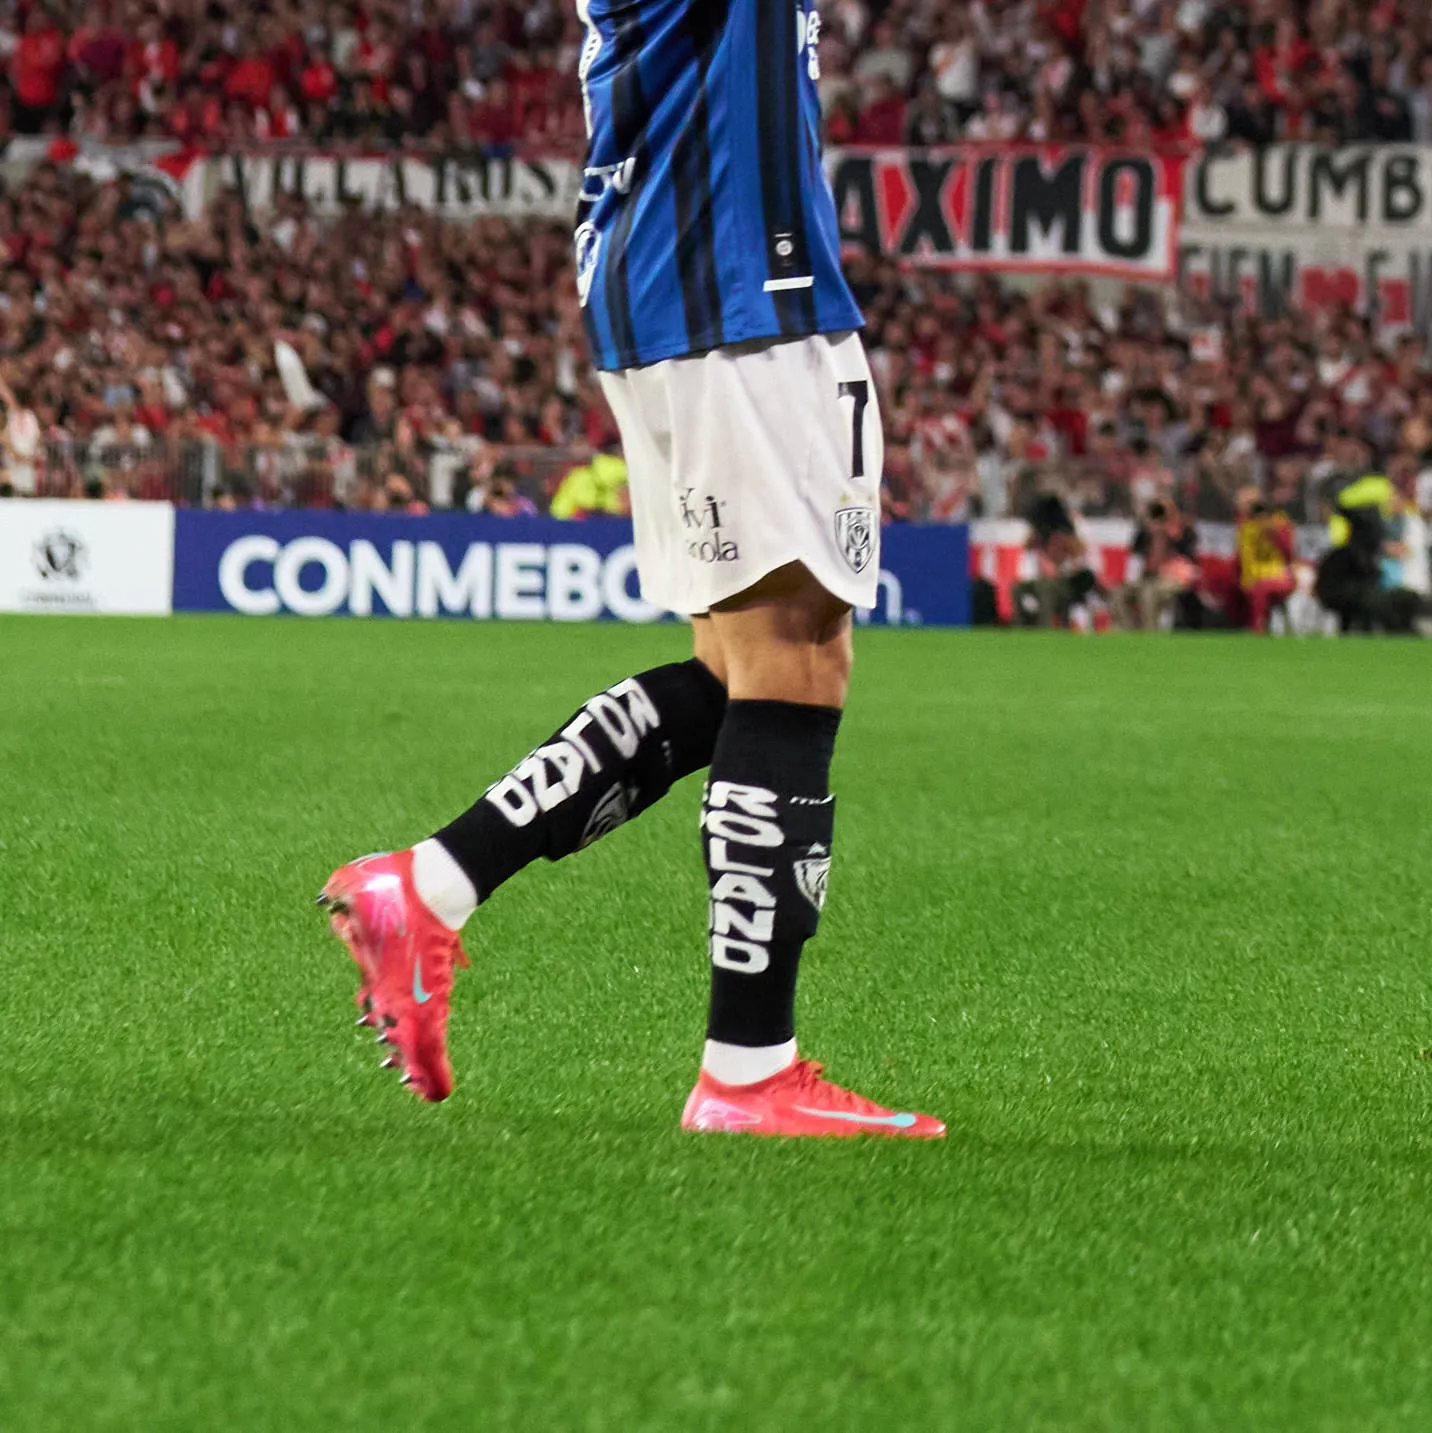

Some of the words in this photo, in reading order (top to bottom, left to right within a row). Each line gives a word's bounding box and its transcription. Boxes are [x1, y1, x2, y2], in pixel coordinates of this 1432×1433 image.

[832, 156, 1157, 260] AXIMO
[837, 379, 869, 479] 7
[219, 534, 676, 621] CONMEBO
[706, 780, 786, 975] ROLAND
